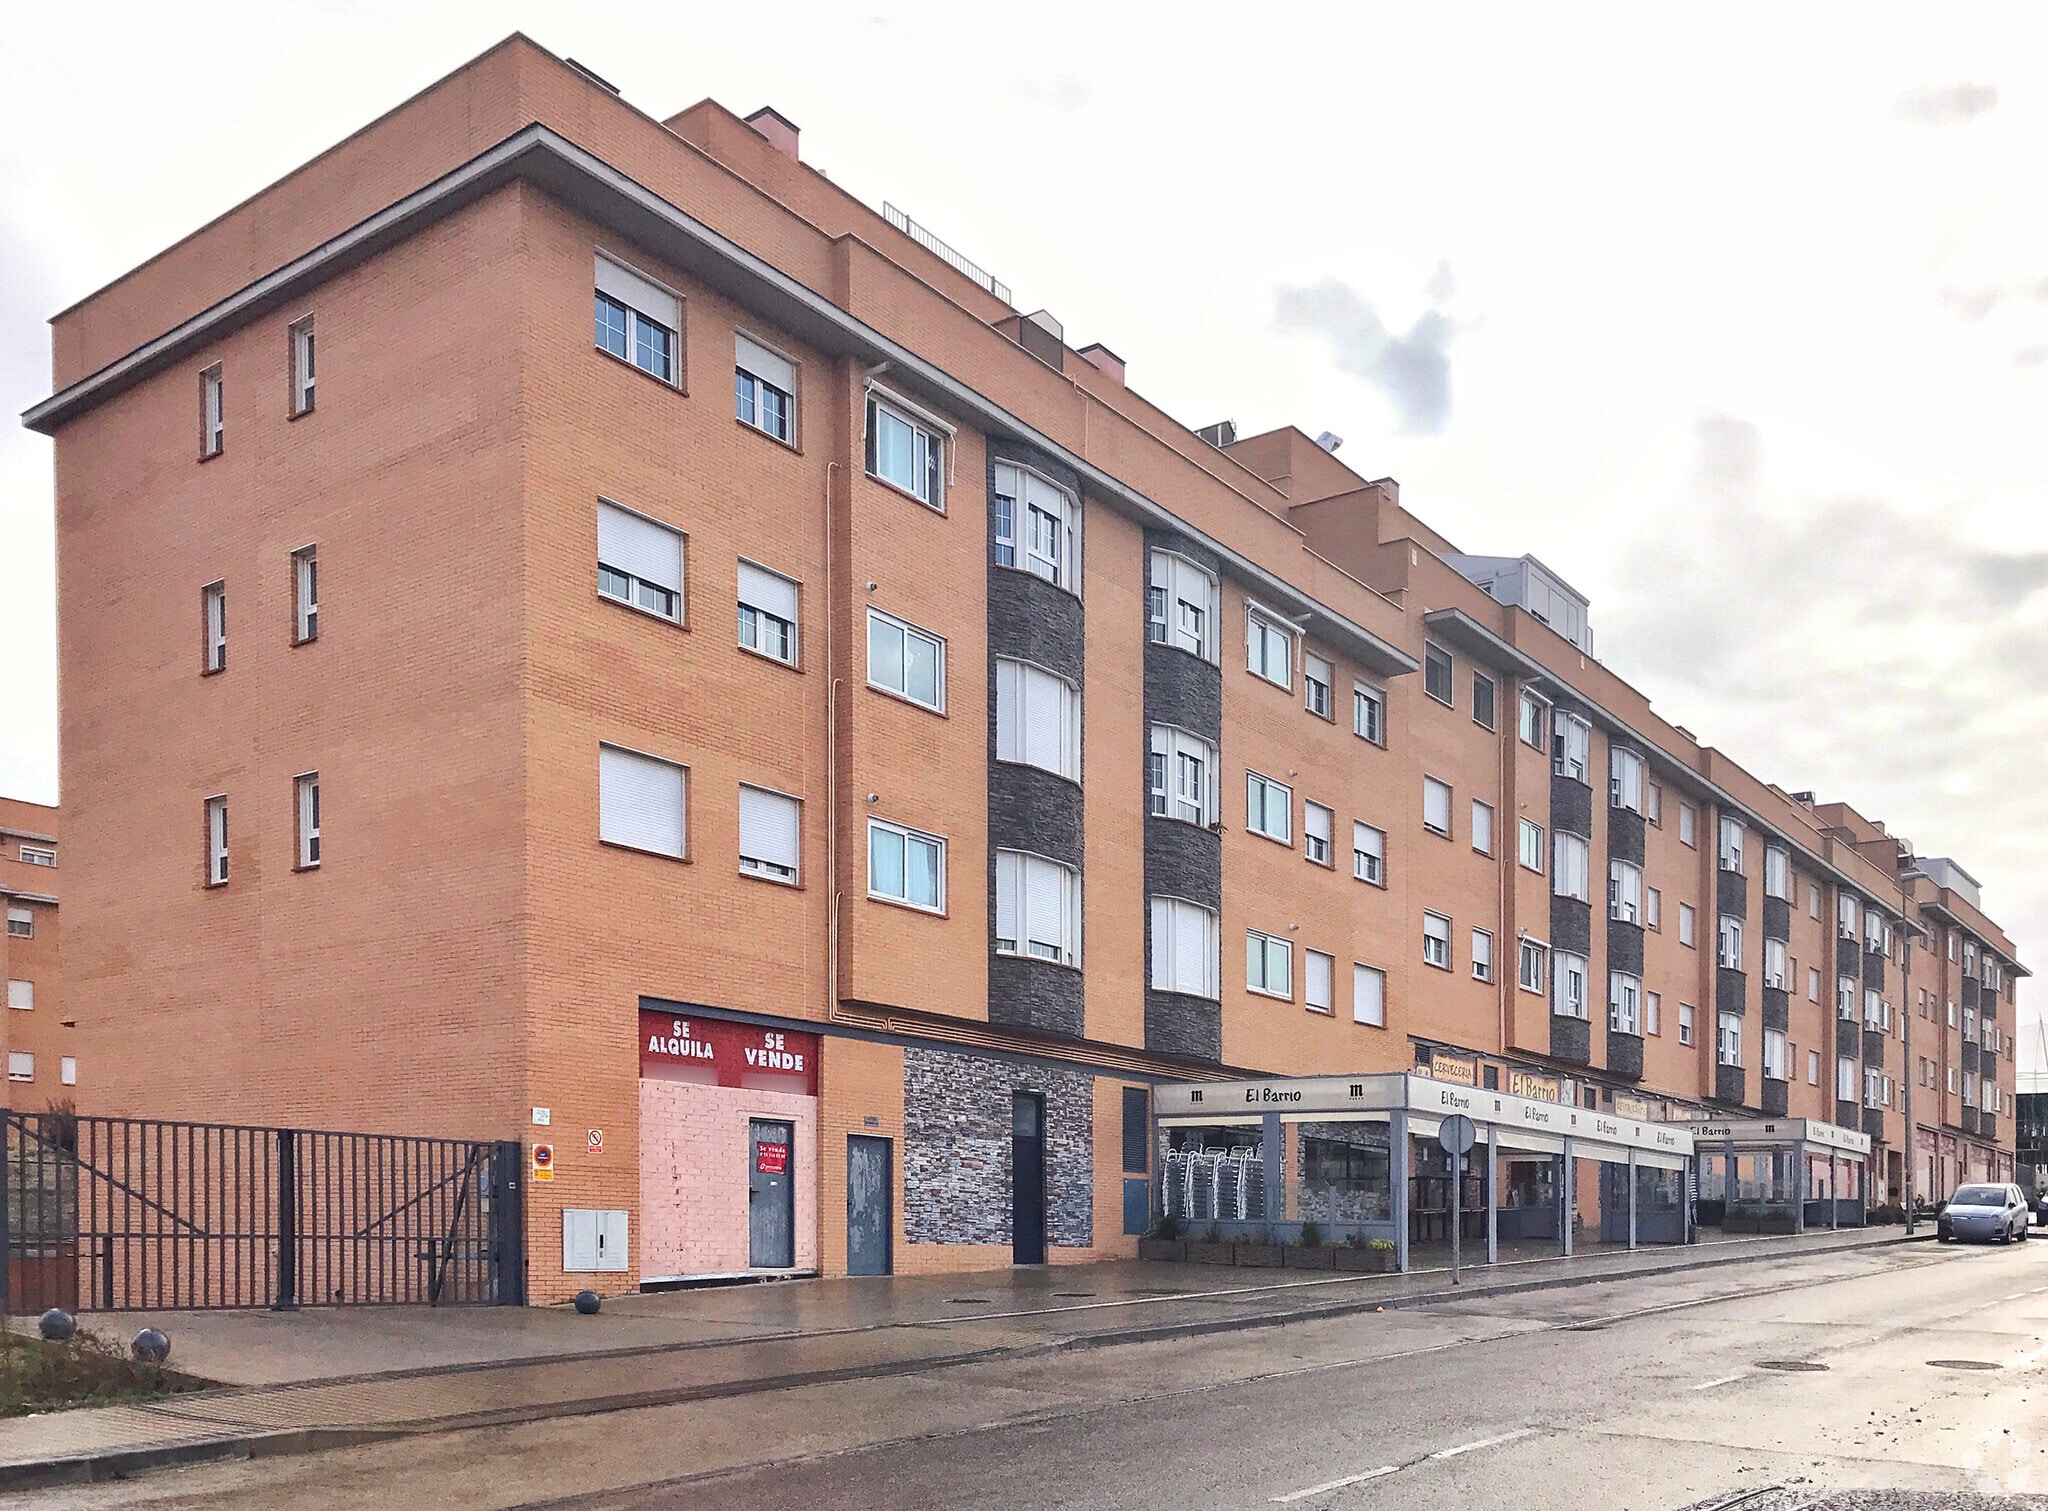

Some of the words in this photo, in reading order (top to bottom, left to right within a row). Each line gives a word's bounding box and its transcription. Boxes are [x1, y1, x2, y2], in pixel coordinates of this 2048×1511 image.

[673, 1020, 690, 1038] SE
[648, 1035, 714, 1060] ALQUILA
[764, 1032, 785, 1050] SE
[744, 1047, 804, 1072] VENDE
[1246, 1089, 1259, 1102] El
[1263, 1087, 1302, 1102] Barrio
[1512, 1074, 1523, 1095] El
[1526, 1077, 1555, 1102] Barrio
[1441, 1090, 1449, 1105] El
[1525, 1105, 1531, 1119] El
[1702, 1126, 1731, 1136] Barrio
